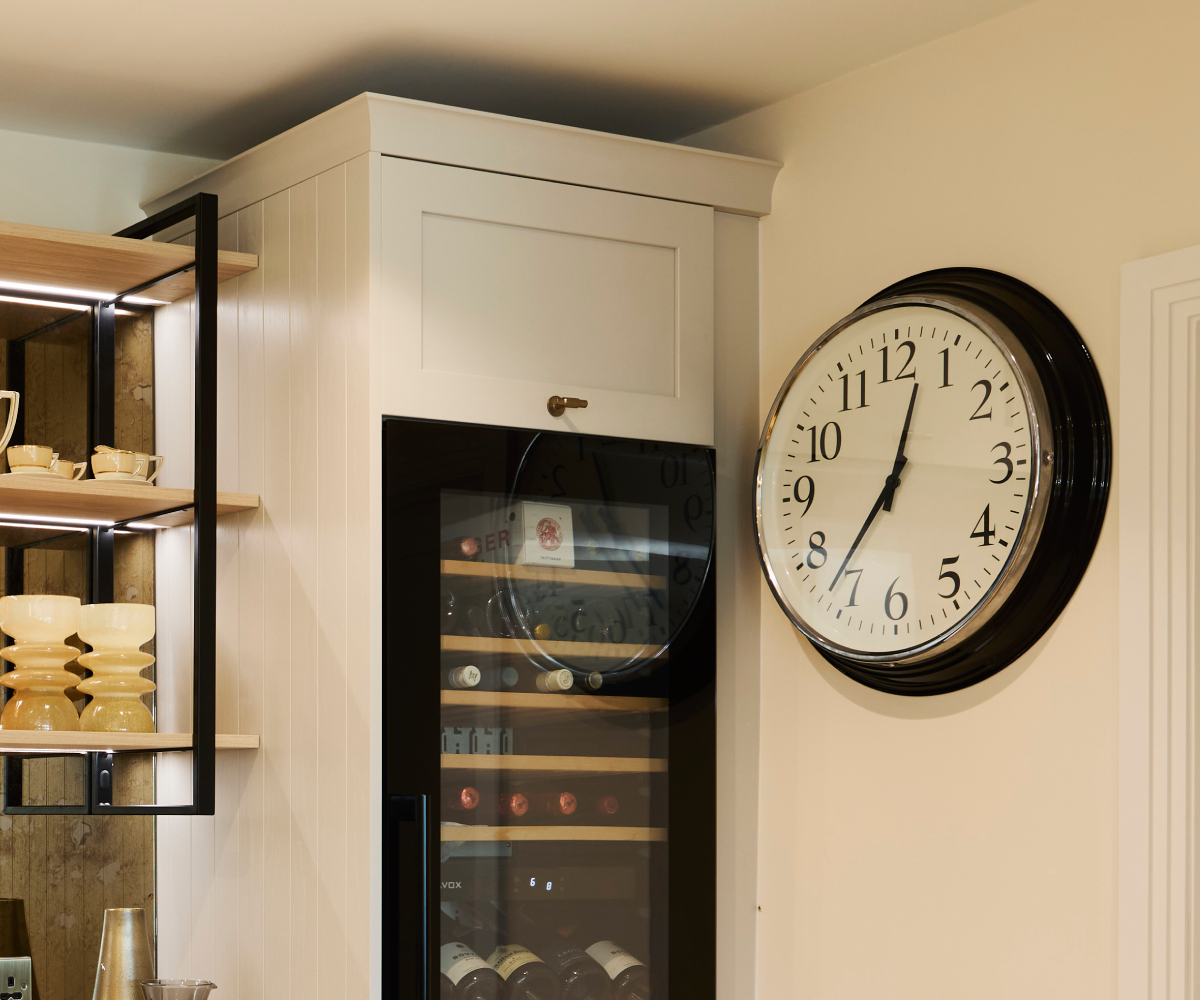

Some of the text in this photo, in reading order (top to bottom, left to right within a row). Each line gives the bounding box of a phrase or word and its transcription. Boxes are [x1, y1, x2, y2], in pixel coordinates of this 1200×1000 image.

[877, 340, 916, 385] 12
[937, 347, 954, 389] 1
[838, 369, 871, 413] 11
[968, 379, 993, 421] 2
[806, 421, 842, 464] 10
[988, 441, 1014, 485] 3
[793, 475, 815, 519] 9
[969, 502, 996, 547] 4
[806, 530, 828, 569] 8
[844, 568, 864, 607] 7
[884, 575, 909, 621] 6
[937, 554, 961, 599] 5
[529, 876, 536, 887] 6
[545, 881, 553, 891] 8
